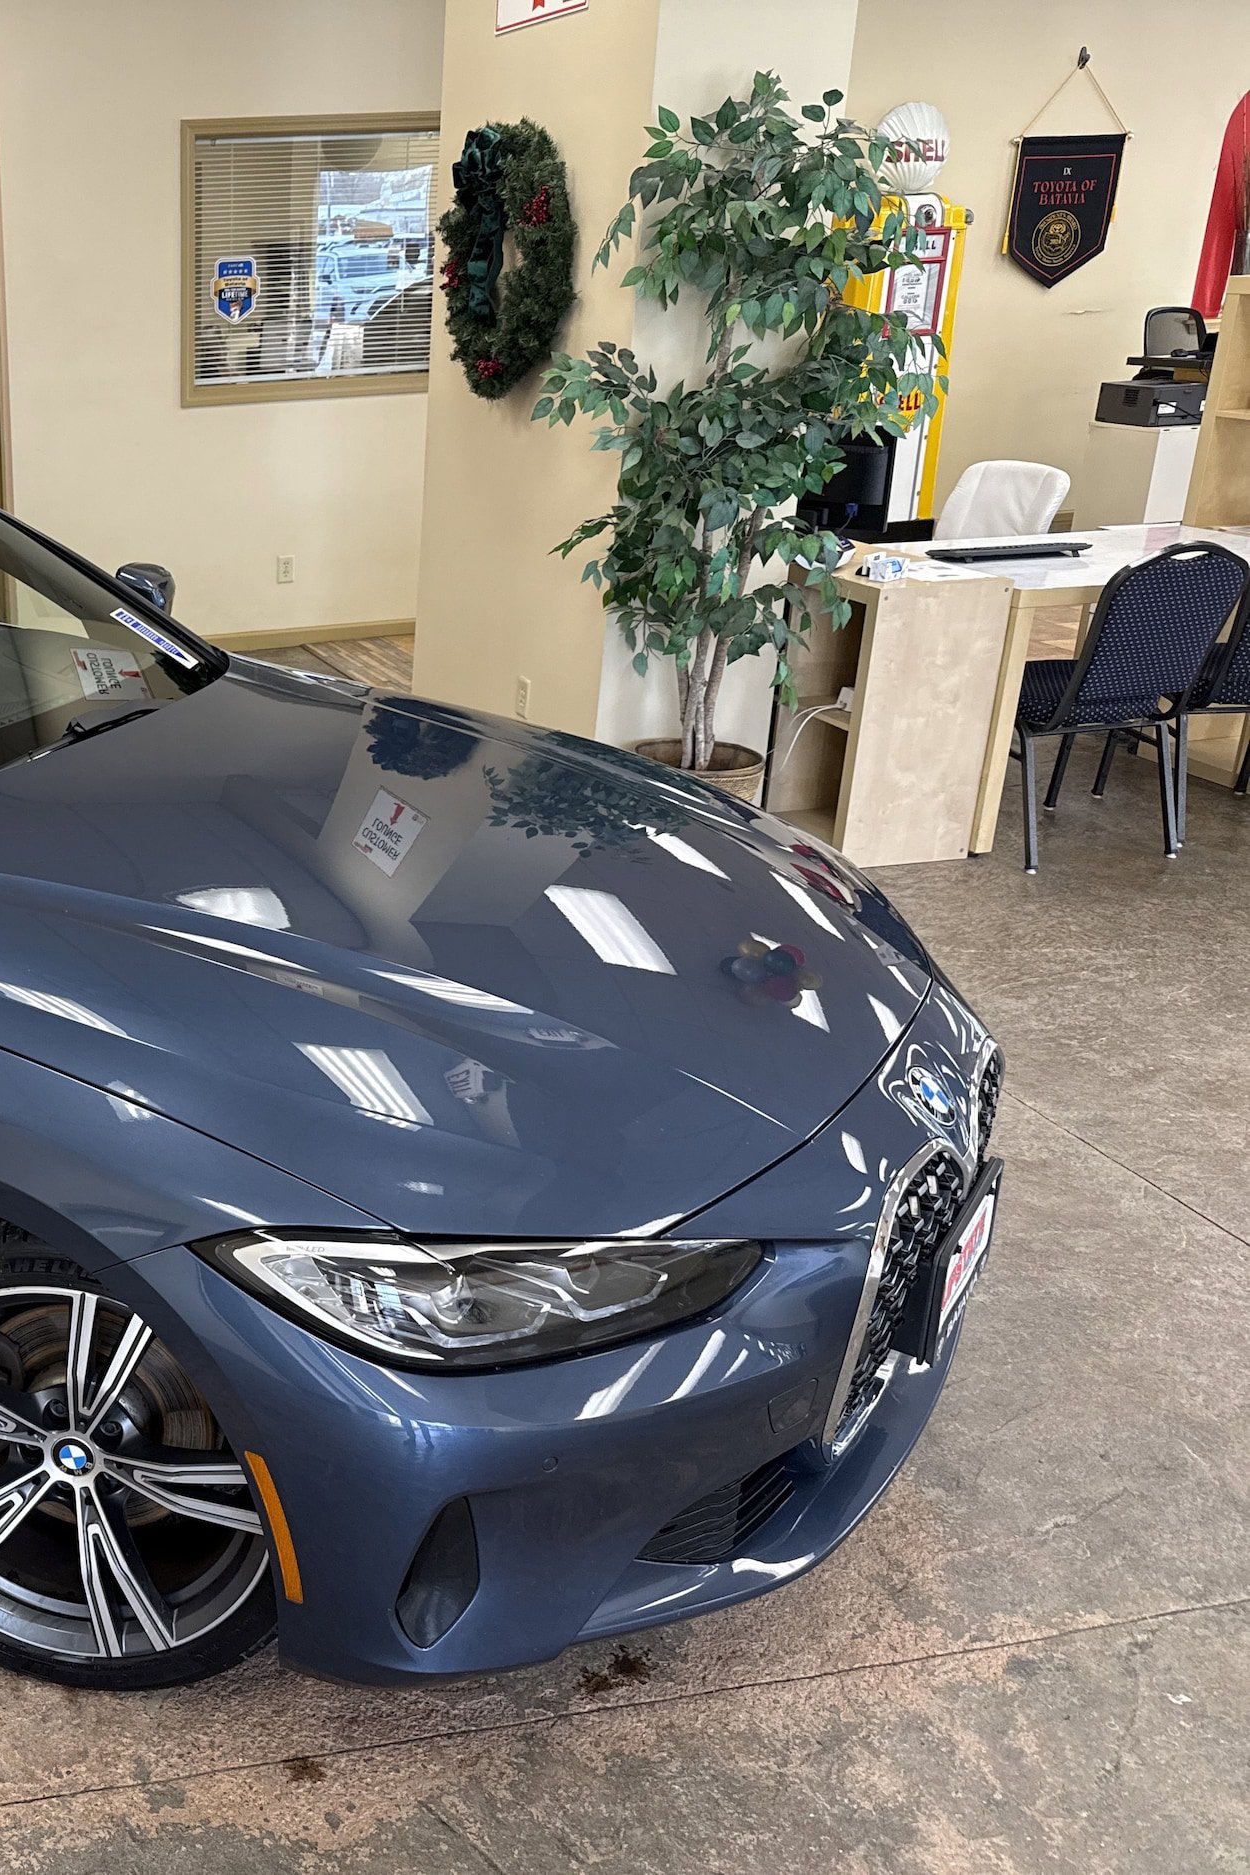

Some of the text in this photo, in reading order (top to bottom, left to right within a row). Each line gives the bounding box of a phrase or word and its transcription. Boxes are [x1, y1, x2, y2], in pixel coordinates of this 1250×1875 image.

[1033, 179, 1097, 193] TOYOTA OF
[1039, 193, 1086, 206] BATAVIA
[222, 291, 248, 299] LIFETIME
